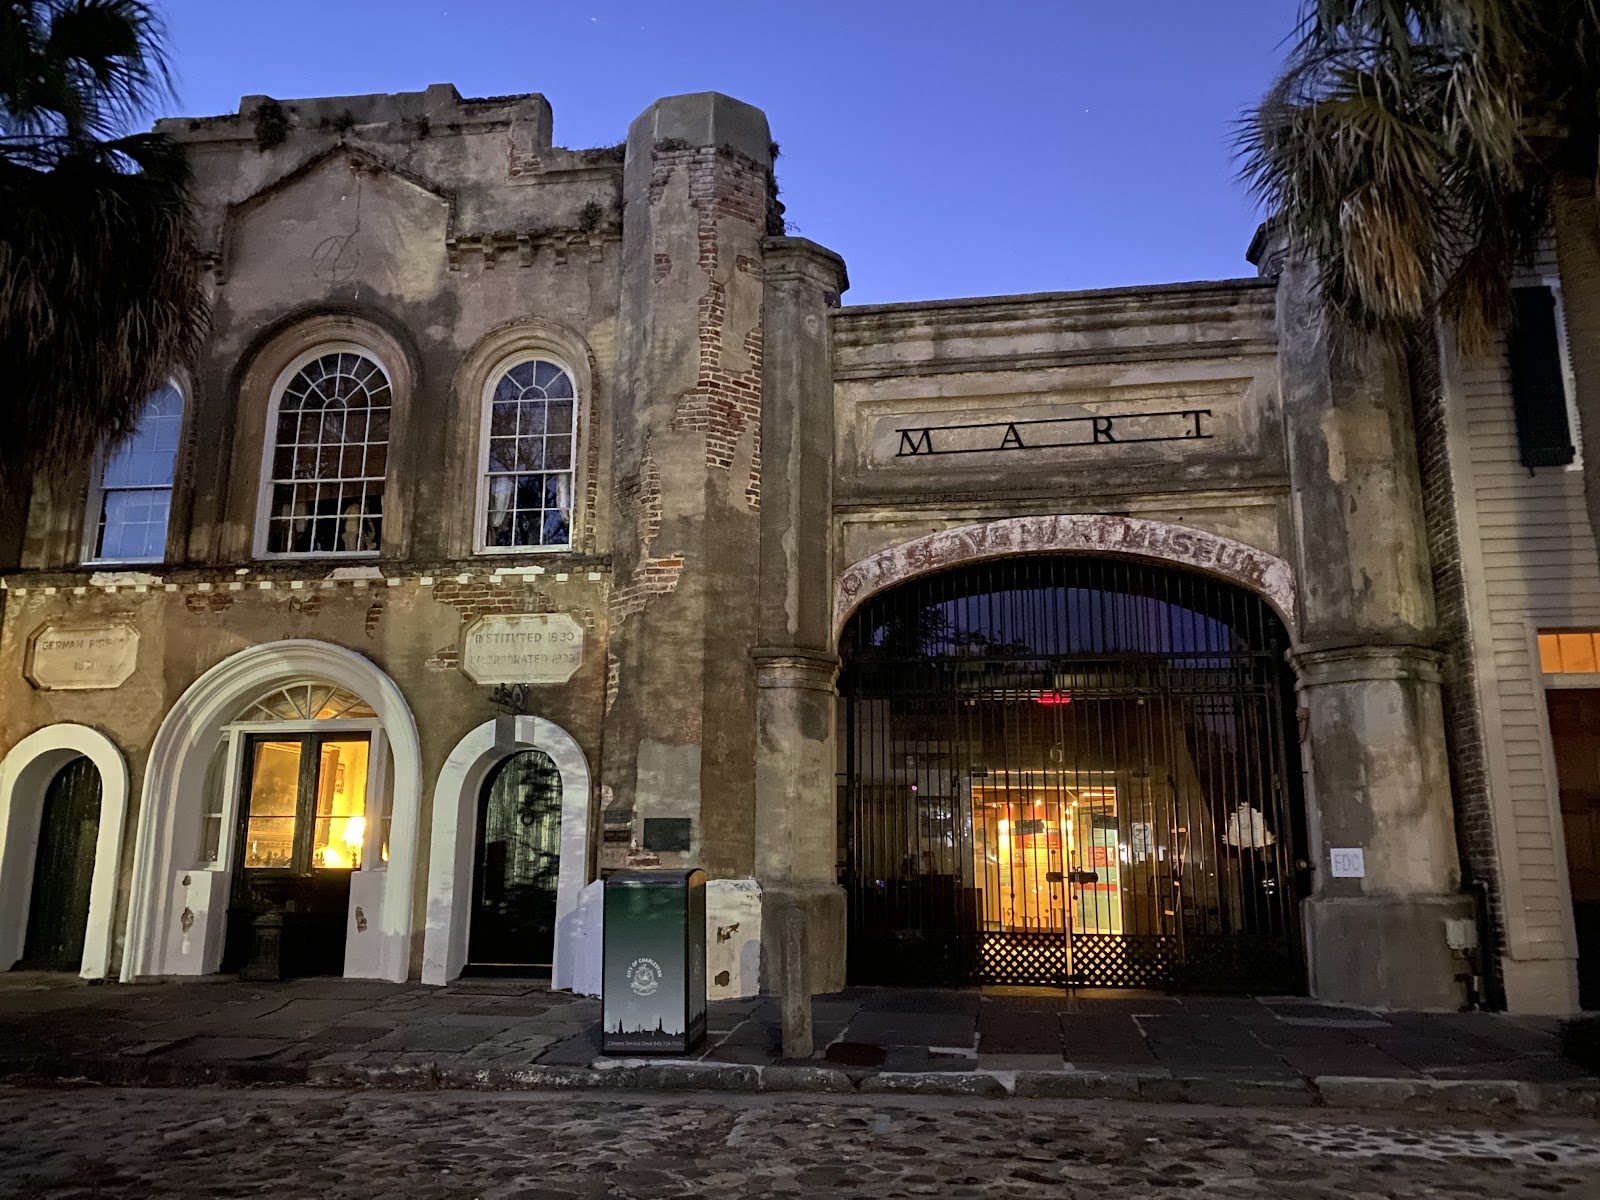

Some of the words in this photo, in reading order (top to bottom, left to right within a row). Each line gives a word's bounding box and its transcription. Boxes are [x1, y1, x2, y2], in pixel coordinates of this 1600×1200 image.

[897, 409, 1212, 456] MART
[42, 639, 84, 651] GERMAN
[475, 632, 542, 644] INSTITUTED
[548, 631, 575, 643] 1830
[1334, 854, 1361, 872] FDC
